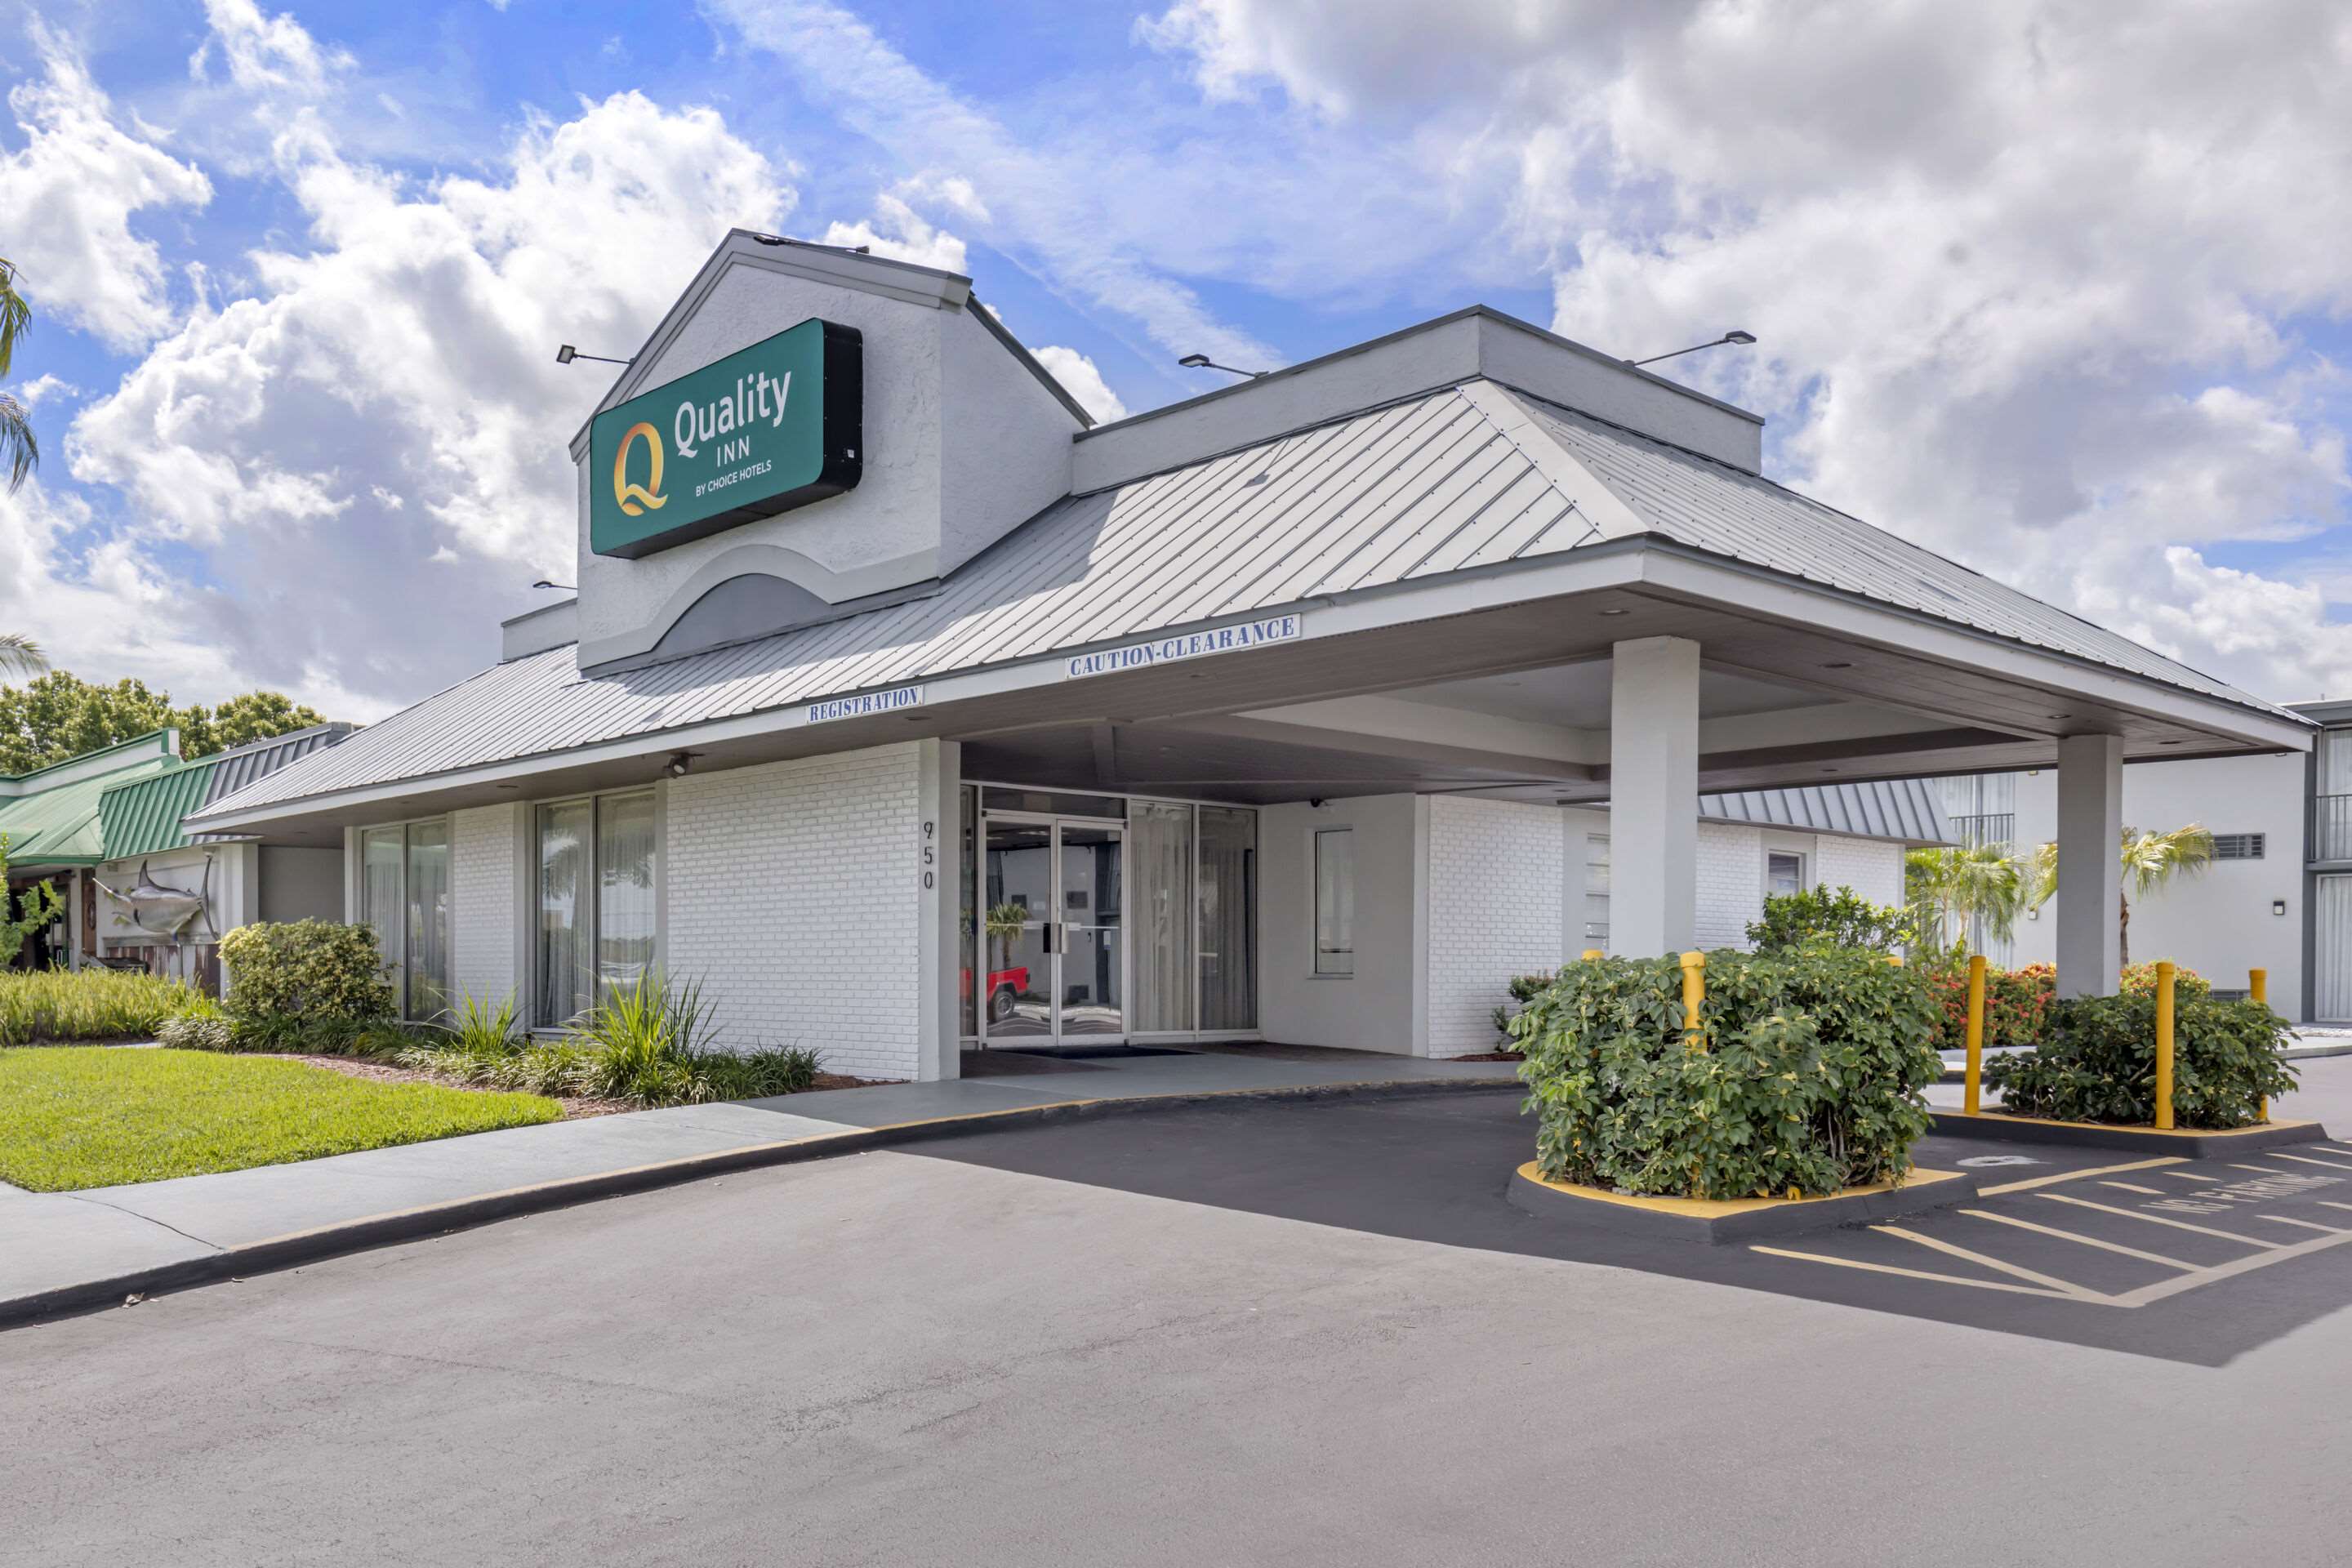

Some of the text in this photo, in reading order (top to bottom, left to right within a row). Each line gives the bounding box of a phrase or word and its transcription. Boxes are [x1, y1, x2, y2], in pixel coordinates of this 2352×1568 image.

[675, 371, 791, 458] Quality
[613, 422, 669, 517] Q
[717, 434, 750, 468] INN
[696, 459, 772, 497] BY CHOICE HOTELS
[810, 688, 918, 721] REGISTRATION
